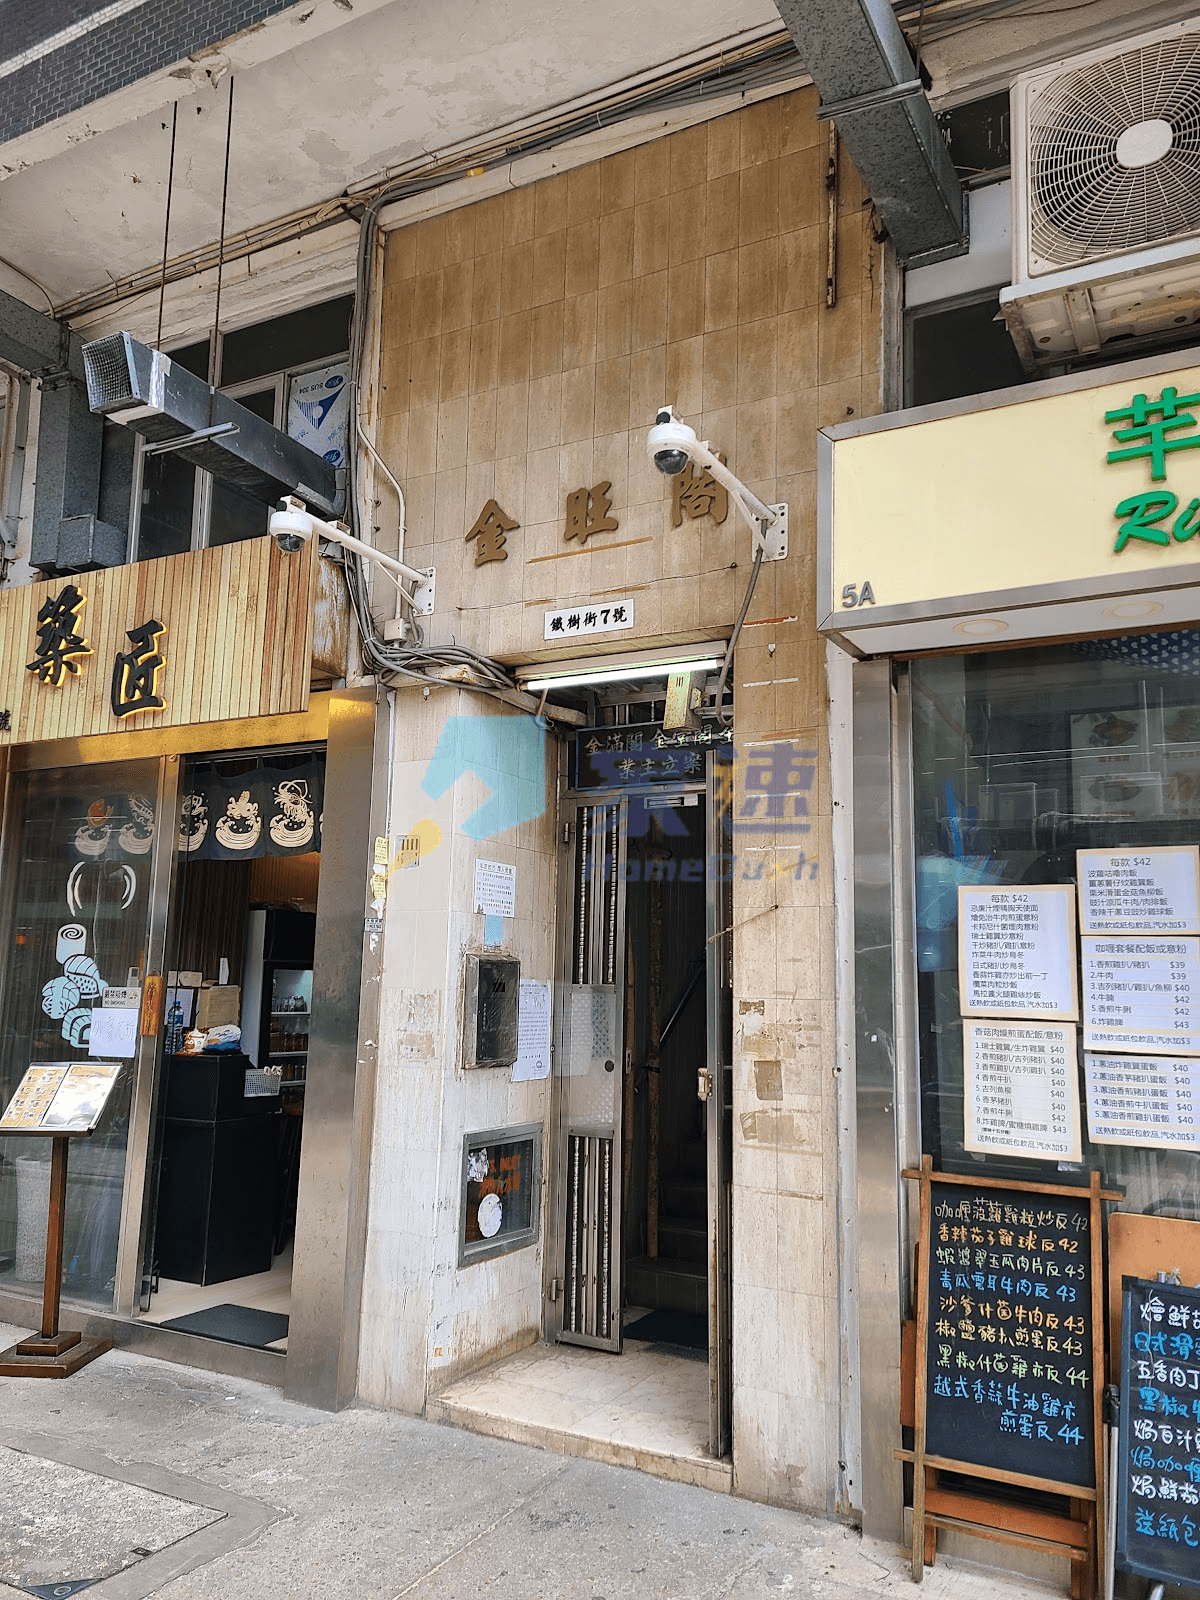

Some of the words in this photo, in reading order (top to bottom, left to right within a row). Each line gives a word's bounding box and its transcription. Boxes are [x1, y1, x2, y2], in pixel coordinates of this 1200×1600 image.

[842, 581, 876, 608] 5A
[550, 606, 627, 632] 鐵樹街7號
[1111, 858, 1130, 867] 每款
[1134, 858, 1151, 866] $42
[991, 895, 1009, 903] 每款
[1090, 972, 1113, 980] 2.牛肉
[1091, 994, 1114, 1002] 4.牛腩
[1051, 1057, 1064, 1065] $40
[1173, 1064, 1188, 1072] $40
[1051, 1090, 1064, 1098] $40
[1176, 1090, 1191, 1098] $40
[1052, 1103, 1065, 1111] $40
[1177, 1103, 1192, 1111] $40
[1052, 1114, 1065, 1122] $42
[1178, 1116, 1193, 1124] $40
[1071, 1213, 1087, 1232] 42
[1058, 1238, 1078, 1253] 42
[1065, 1264, 1085, 1280] 43
[1056, 1284, 1076, 1302] 43
[1064, 1316, 1085, 1334] 43
[1062, 1337, 1083, 1356] 43
[1066, 1367, 1089, 1389] 44
[1000, 1410, 1053, 1441] 煎蛋反
[1058, 1424, 1085, 1446] 44
